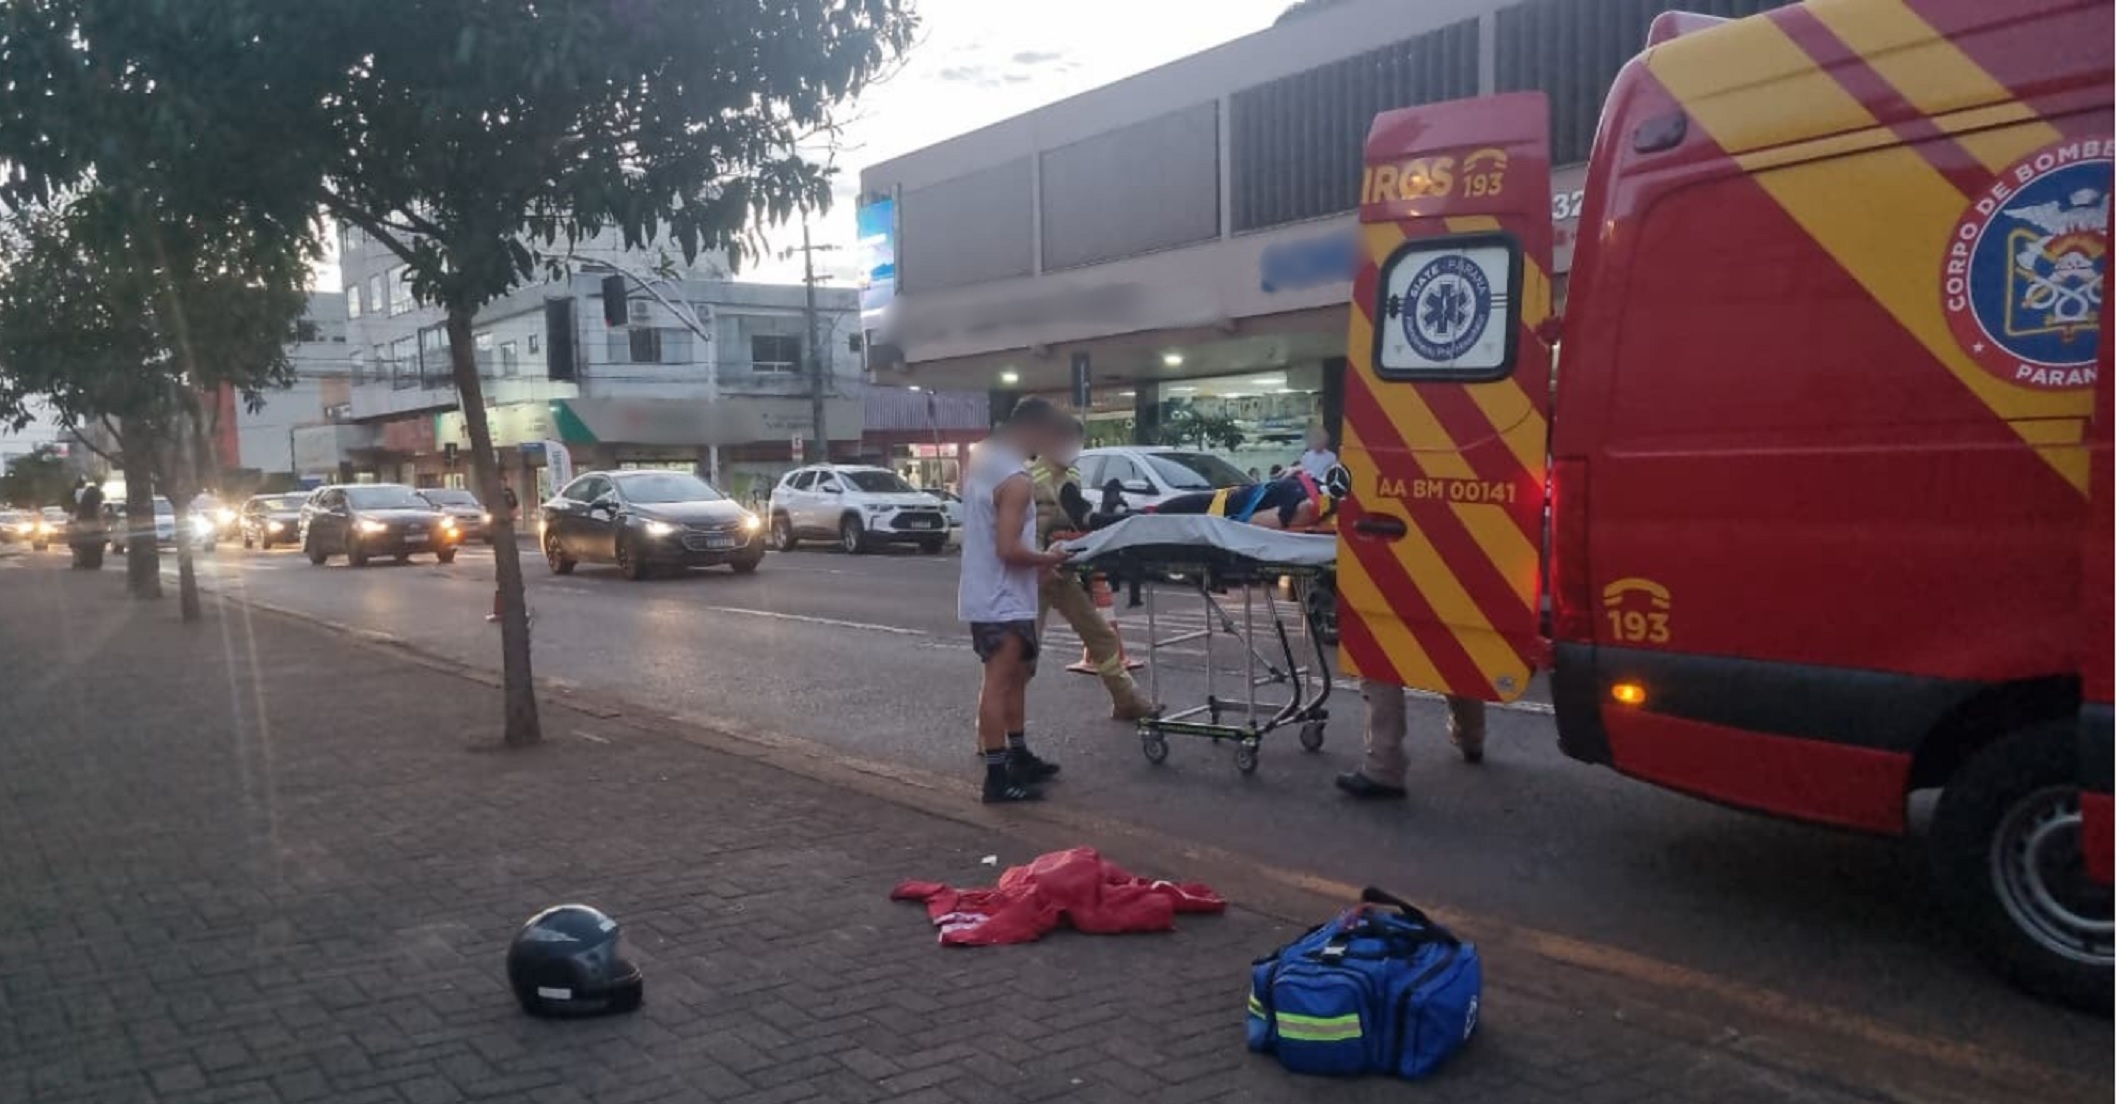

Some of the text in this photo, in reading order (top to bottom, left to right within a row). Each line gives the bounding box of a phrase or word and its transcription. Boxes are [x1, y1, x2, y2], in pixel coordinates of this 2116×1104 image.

[1463, 172, 1505, 198] 193
[1946, 223, 1979, 312] CORPO
[1976, 181, 2012, 216] DE
[1379, 478, 1516, 503] AA BM 00141
[1607, 611, 1671, 644] 193
